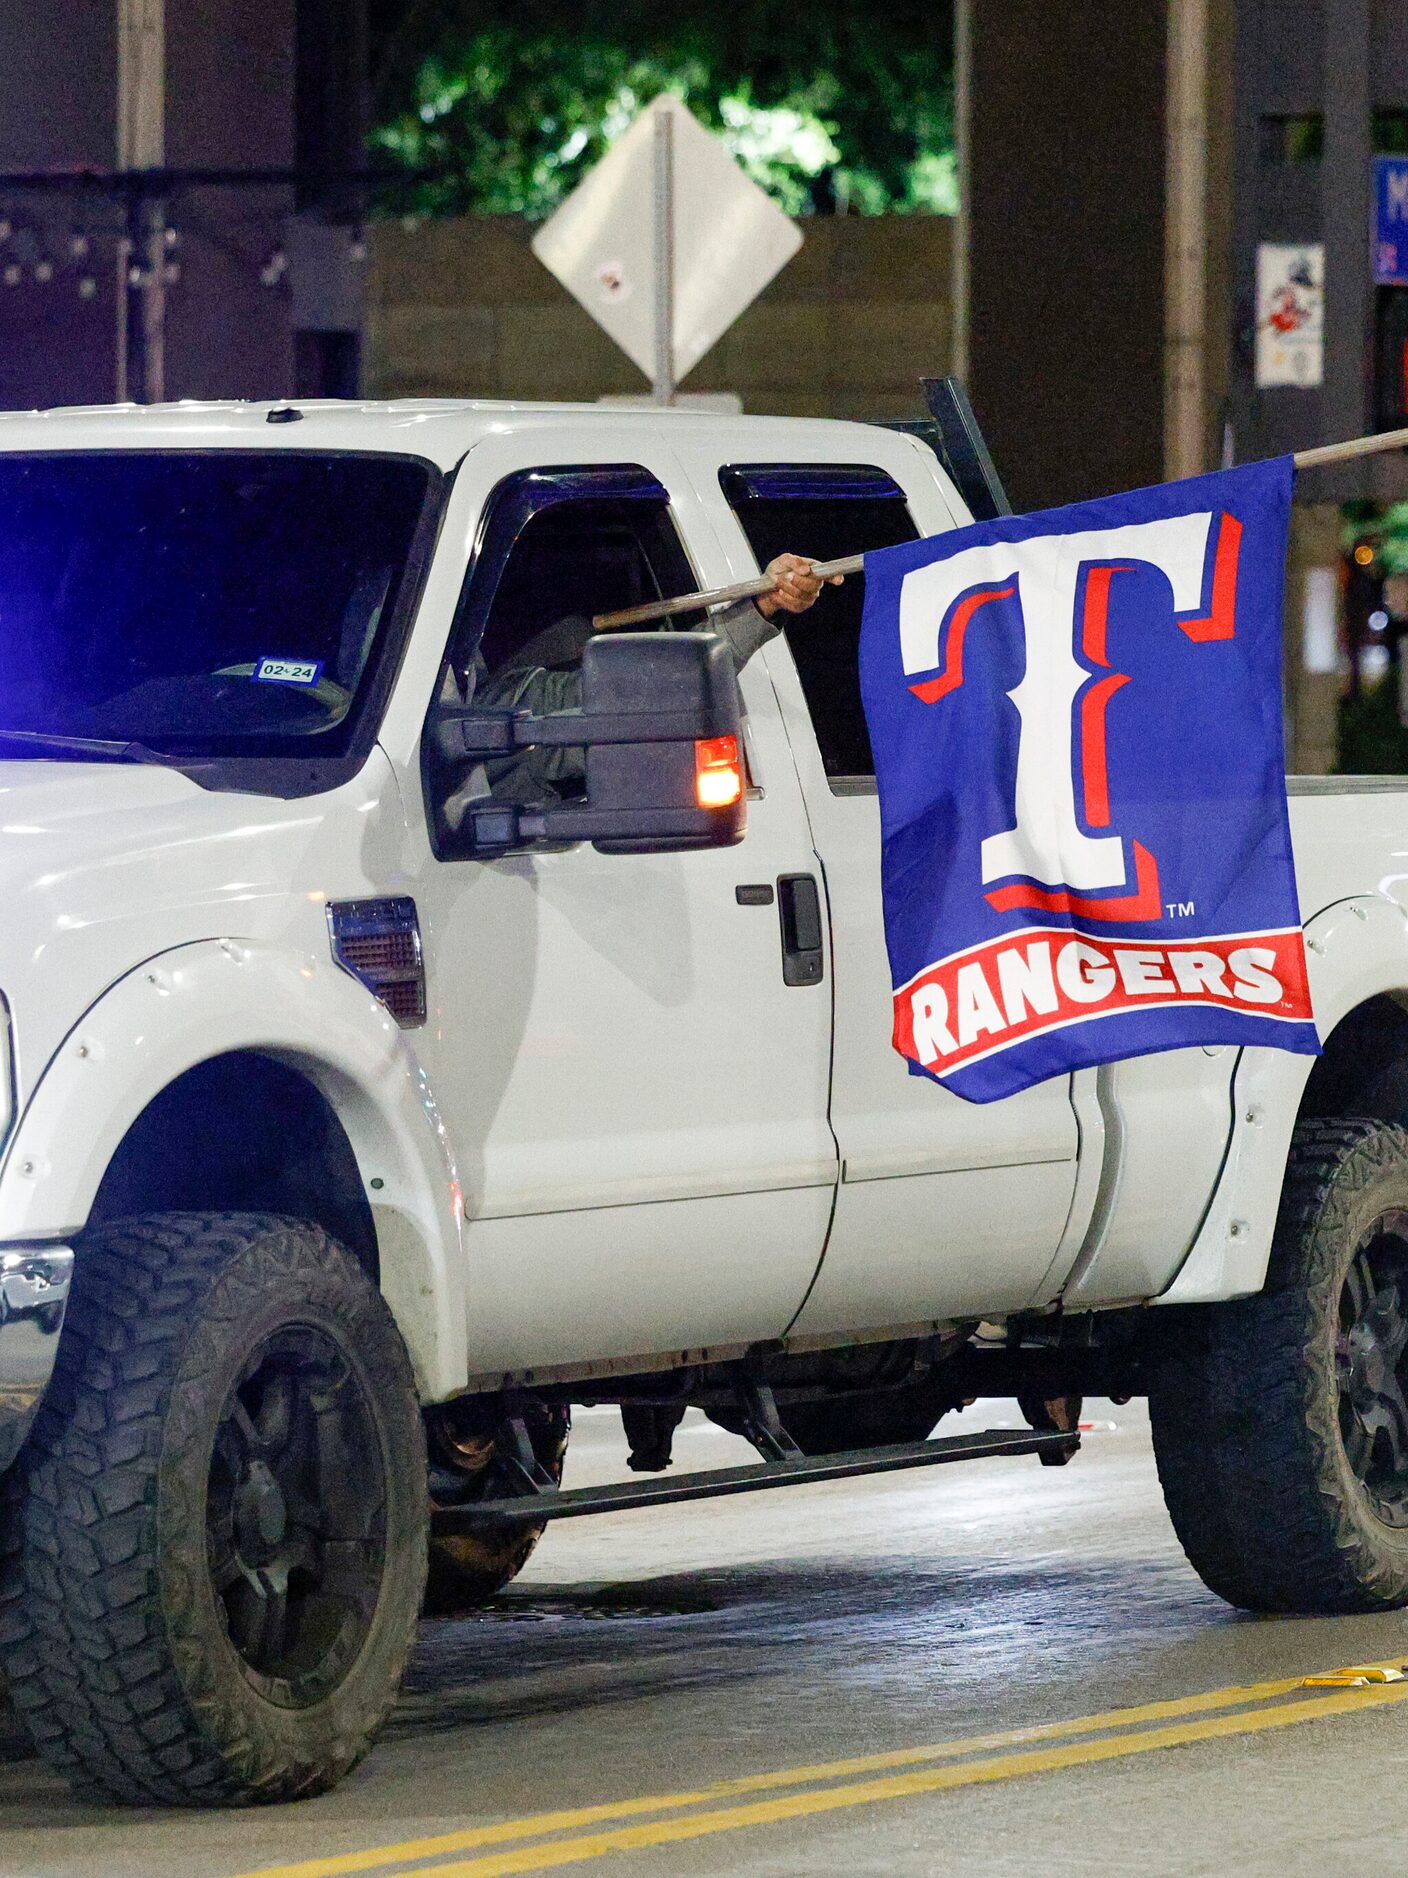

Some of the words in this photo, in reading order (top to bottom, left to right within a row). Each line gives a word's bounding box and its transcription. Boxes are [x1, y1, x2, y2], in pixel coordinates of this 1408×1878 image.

[900, 511, 1243, 923] T
[1166, 901, 1195, 919] TM
[911, 940, 1283, 1065] RANGERS
